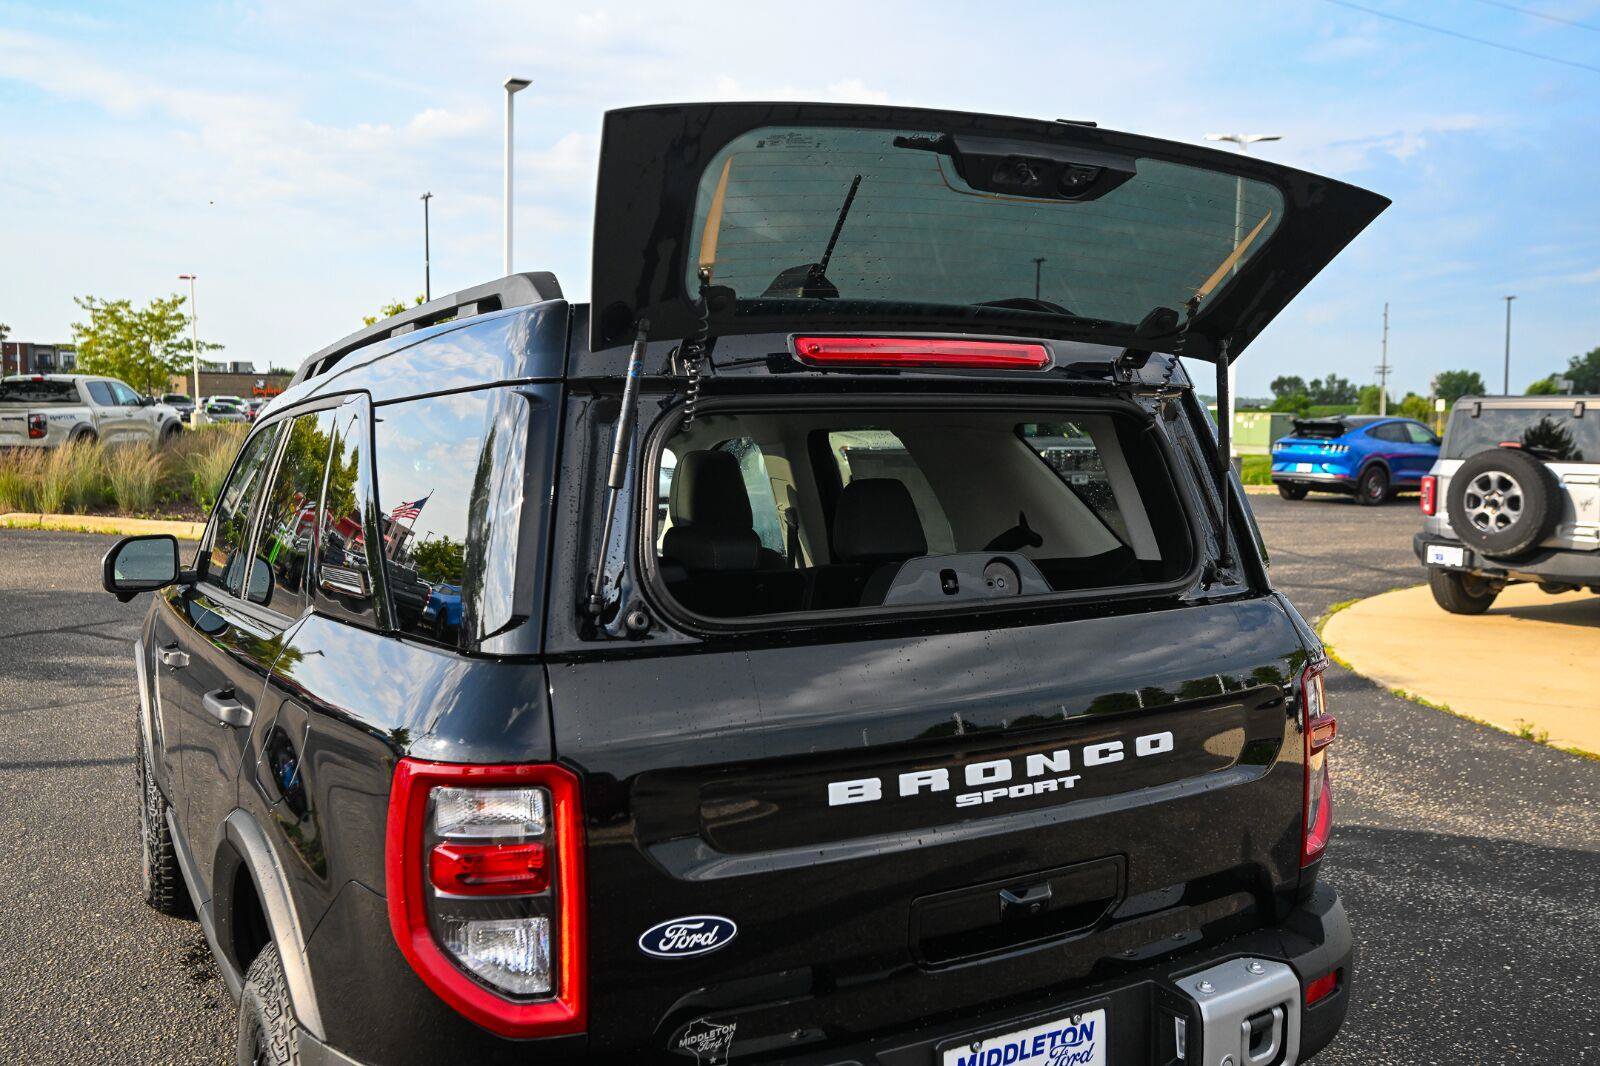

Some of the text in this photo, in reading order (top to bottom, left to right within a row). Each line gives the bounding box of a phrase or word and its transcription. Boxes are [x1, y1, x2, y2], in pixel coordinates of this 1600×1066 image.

[828, 731, 1174, 807] BRONCO
[955, 774, 1082, 808] SPORT
[658, 922, 719, 951] Ford
[679, 1022, 737, 1048] MIDDLETON
[697, 1037, 722, 1052] Ford
[1045, 1041, 1095, 1066] Ford
